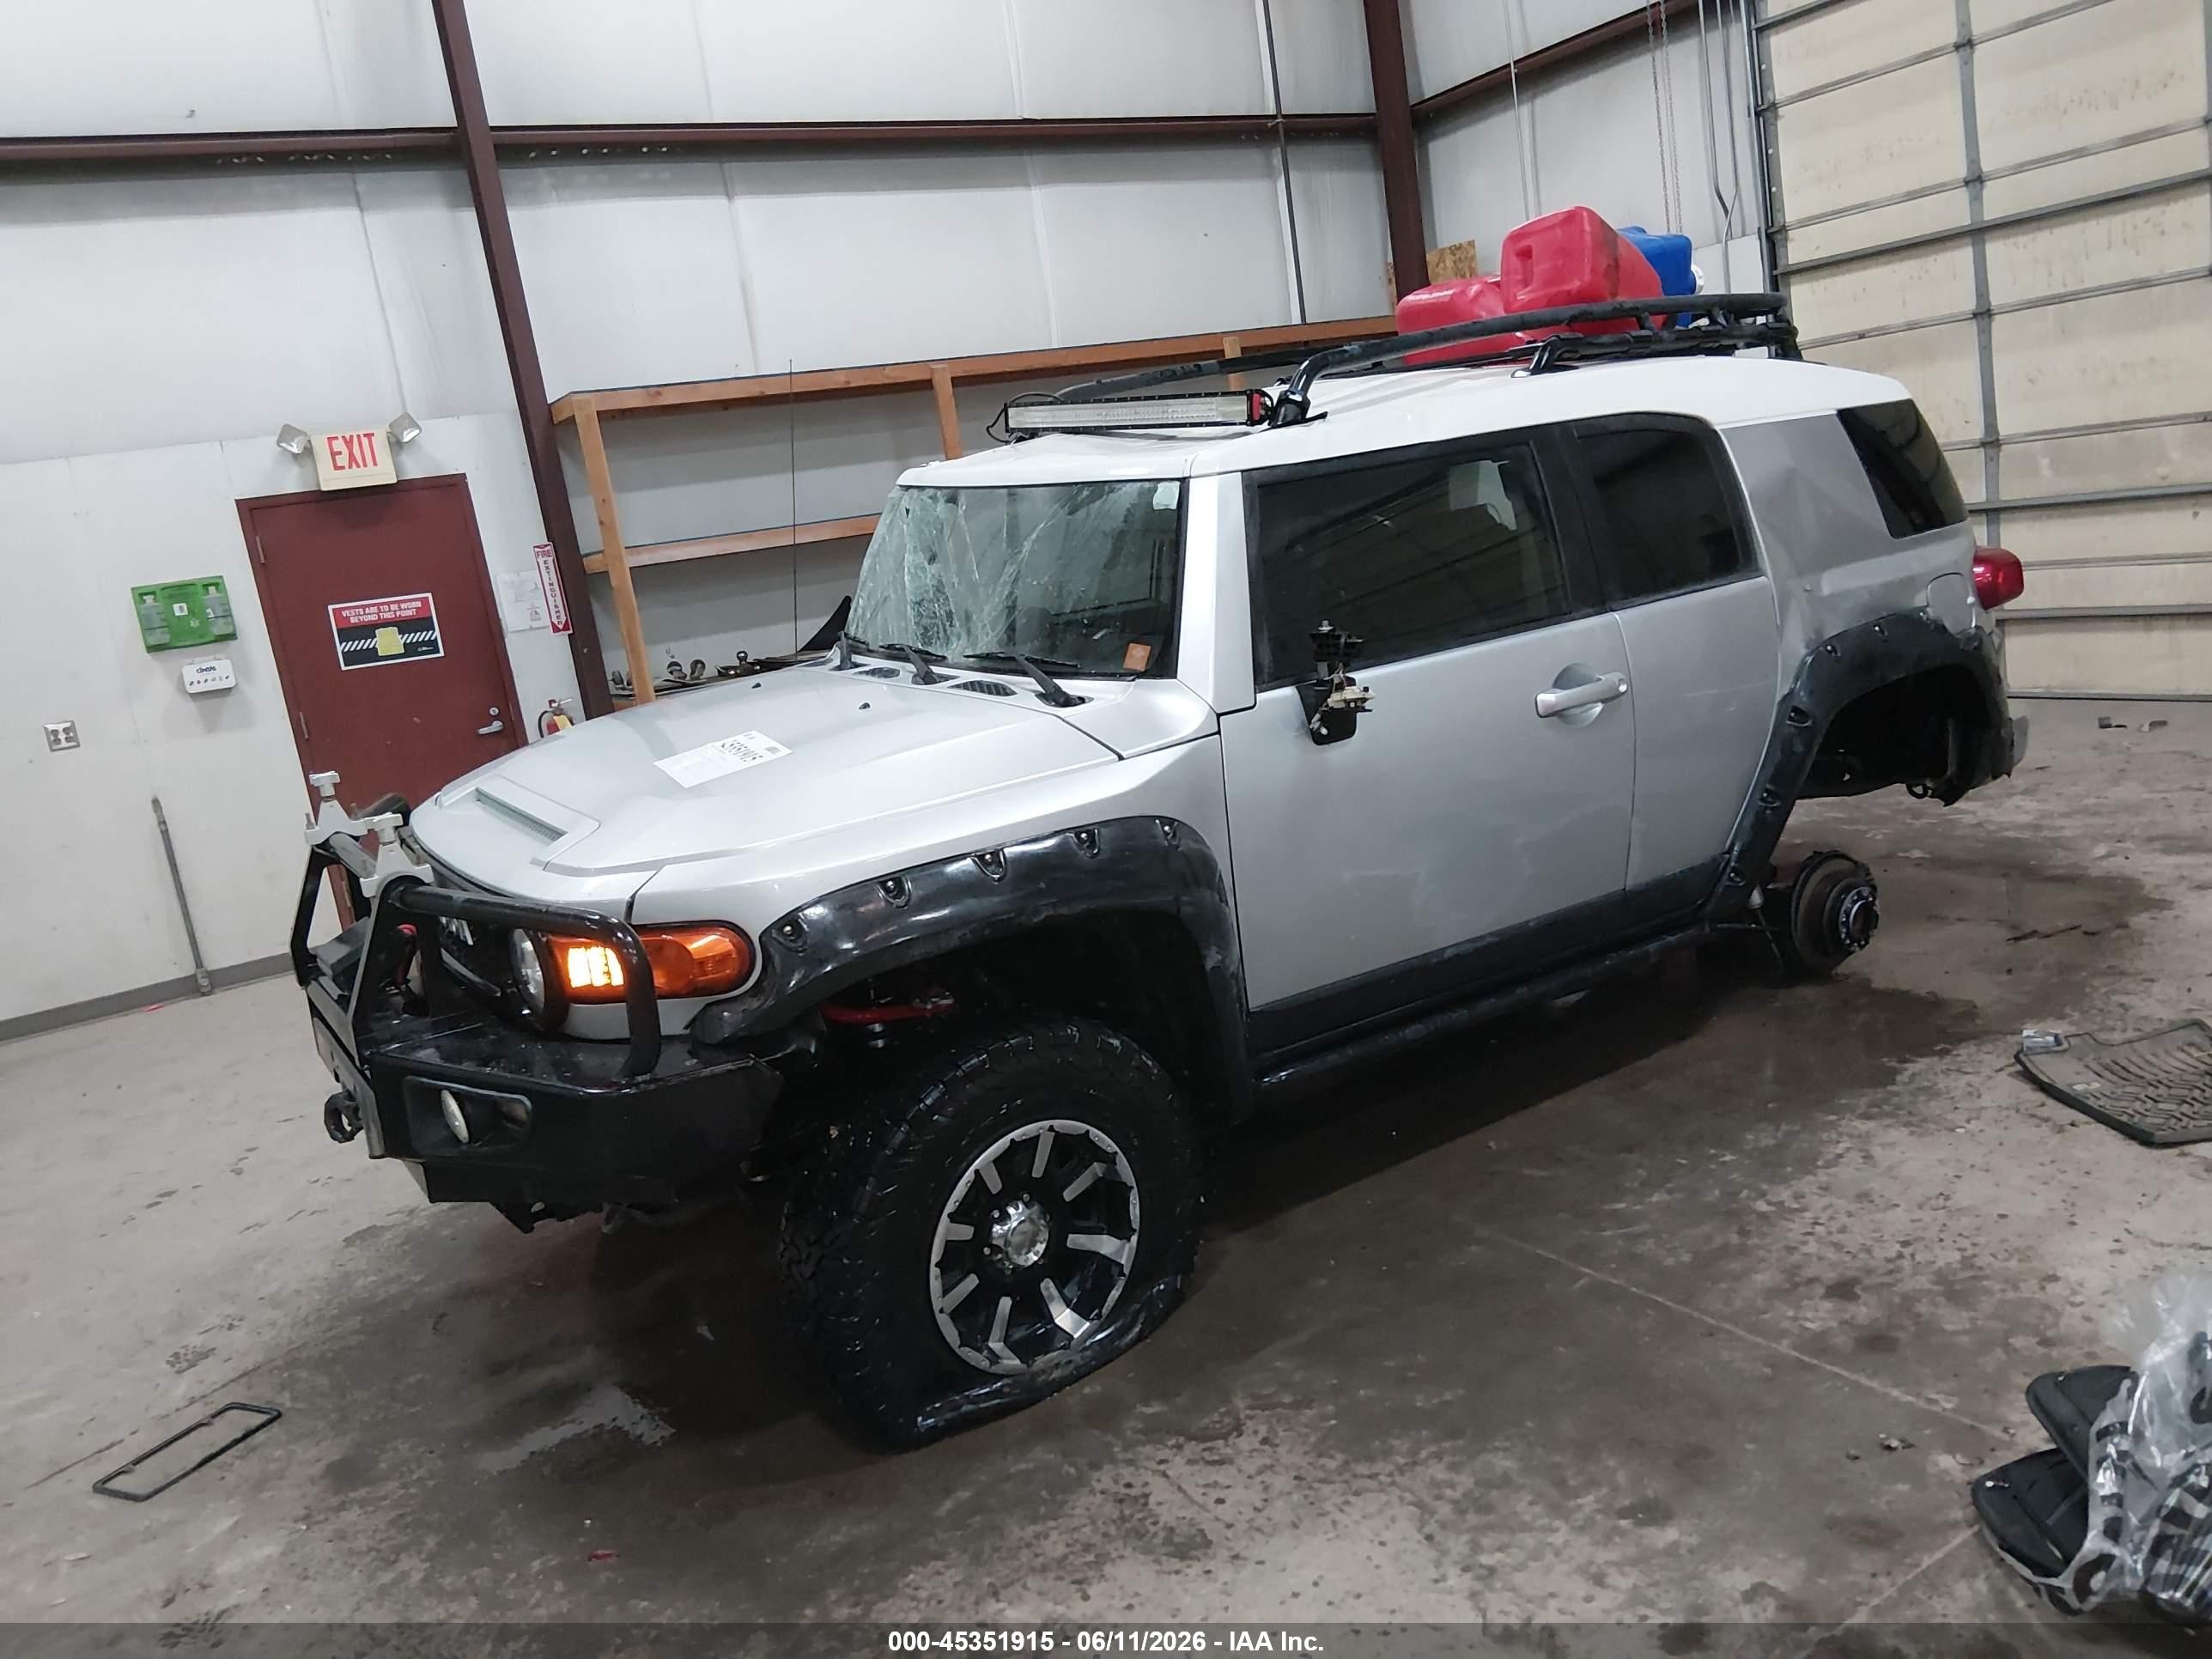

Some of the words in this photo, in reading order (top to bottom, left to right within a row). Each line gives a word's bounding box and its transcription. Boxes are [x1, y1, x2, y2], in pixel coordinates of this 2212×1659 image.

[326, 432, 378, 471] EXIT
[536, 550, 552, 558] FIRE
[544, 560, 563, 626] EXTINGUISHER
[341, 608, 364, 617] VESTS
[399, 601, 422, 610] WORN
[349, 614, 378, 623] BEYOND
[396, 609, 416, 617] POINT
